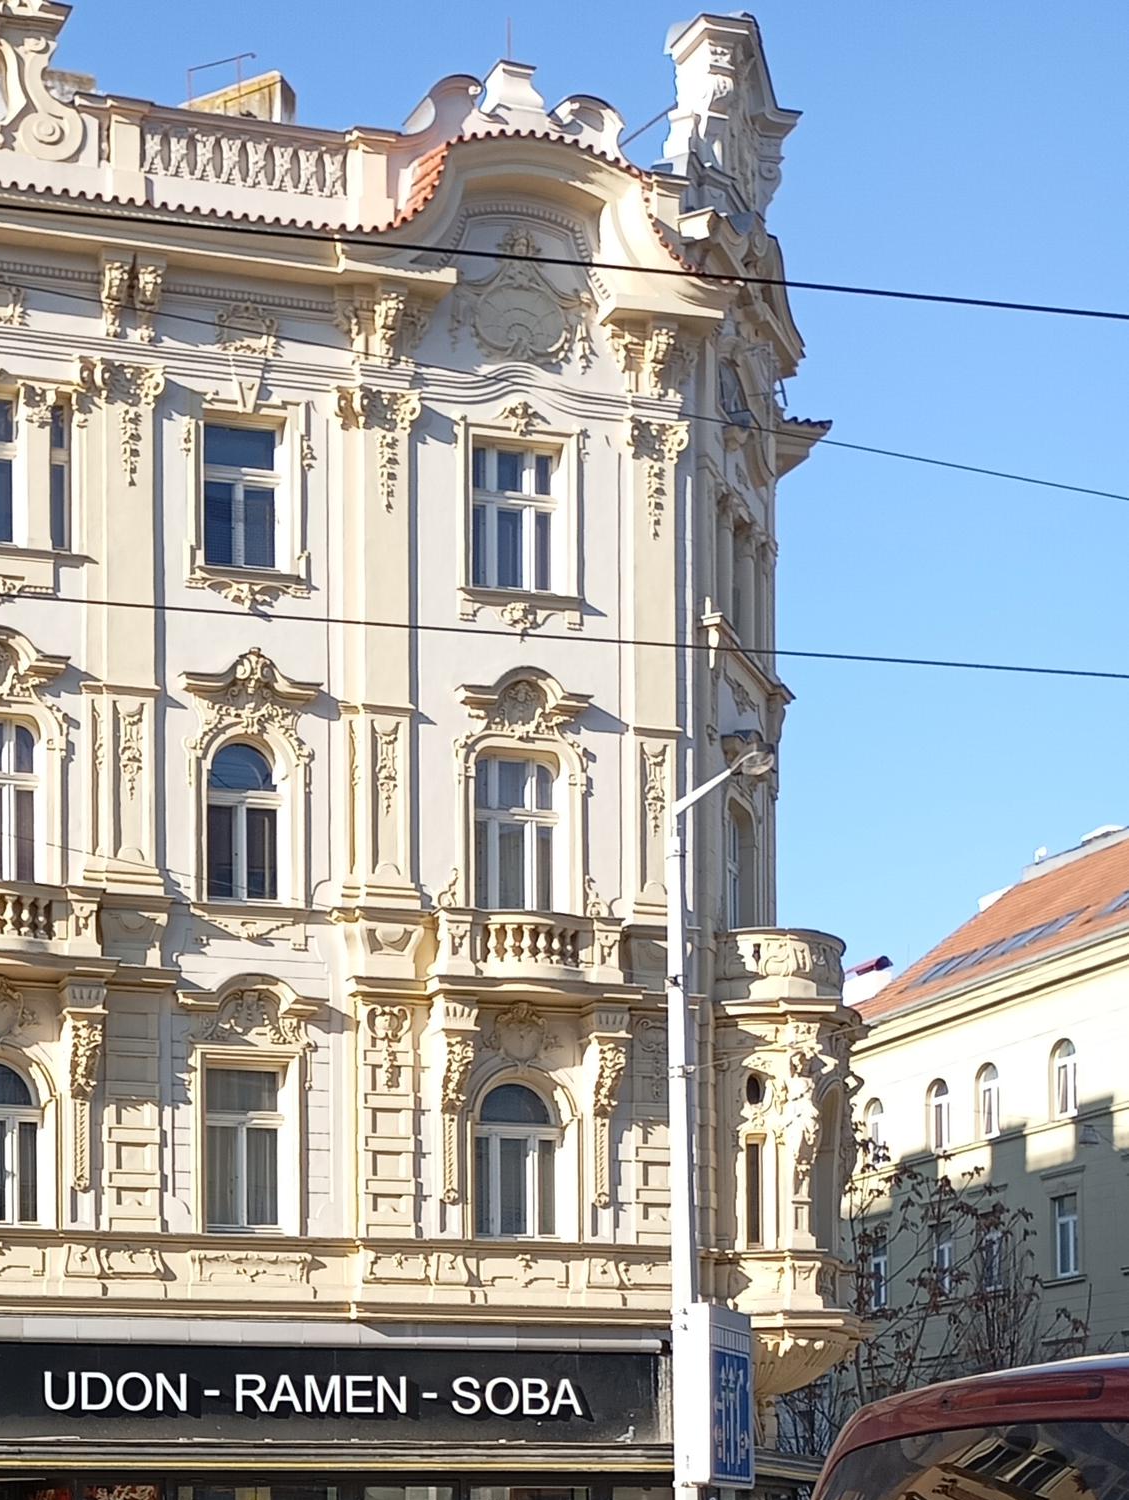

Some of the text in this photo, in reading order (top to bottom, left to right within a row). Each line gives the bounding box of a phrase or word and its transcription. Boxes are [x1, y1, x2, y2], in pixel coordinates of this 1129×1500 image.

[43, 1371, 188, 1411] UDON
[235, 1373, 408, 1414] RAMEN
[451, 1376, 584, 1416] SOBA
